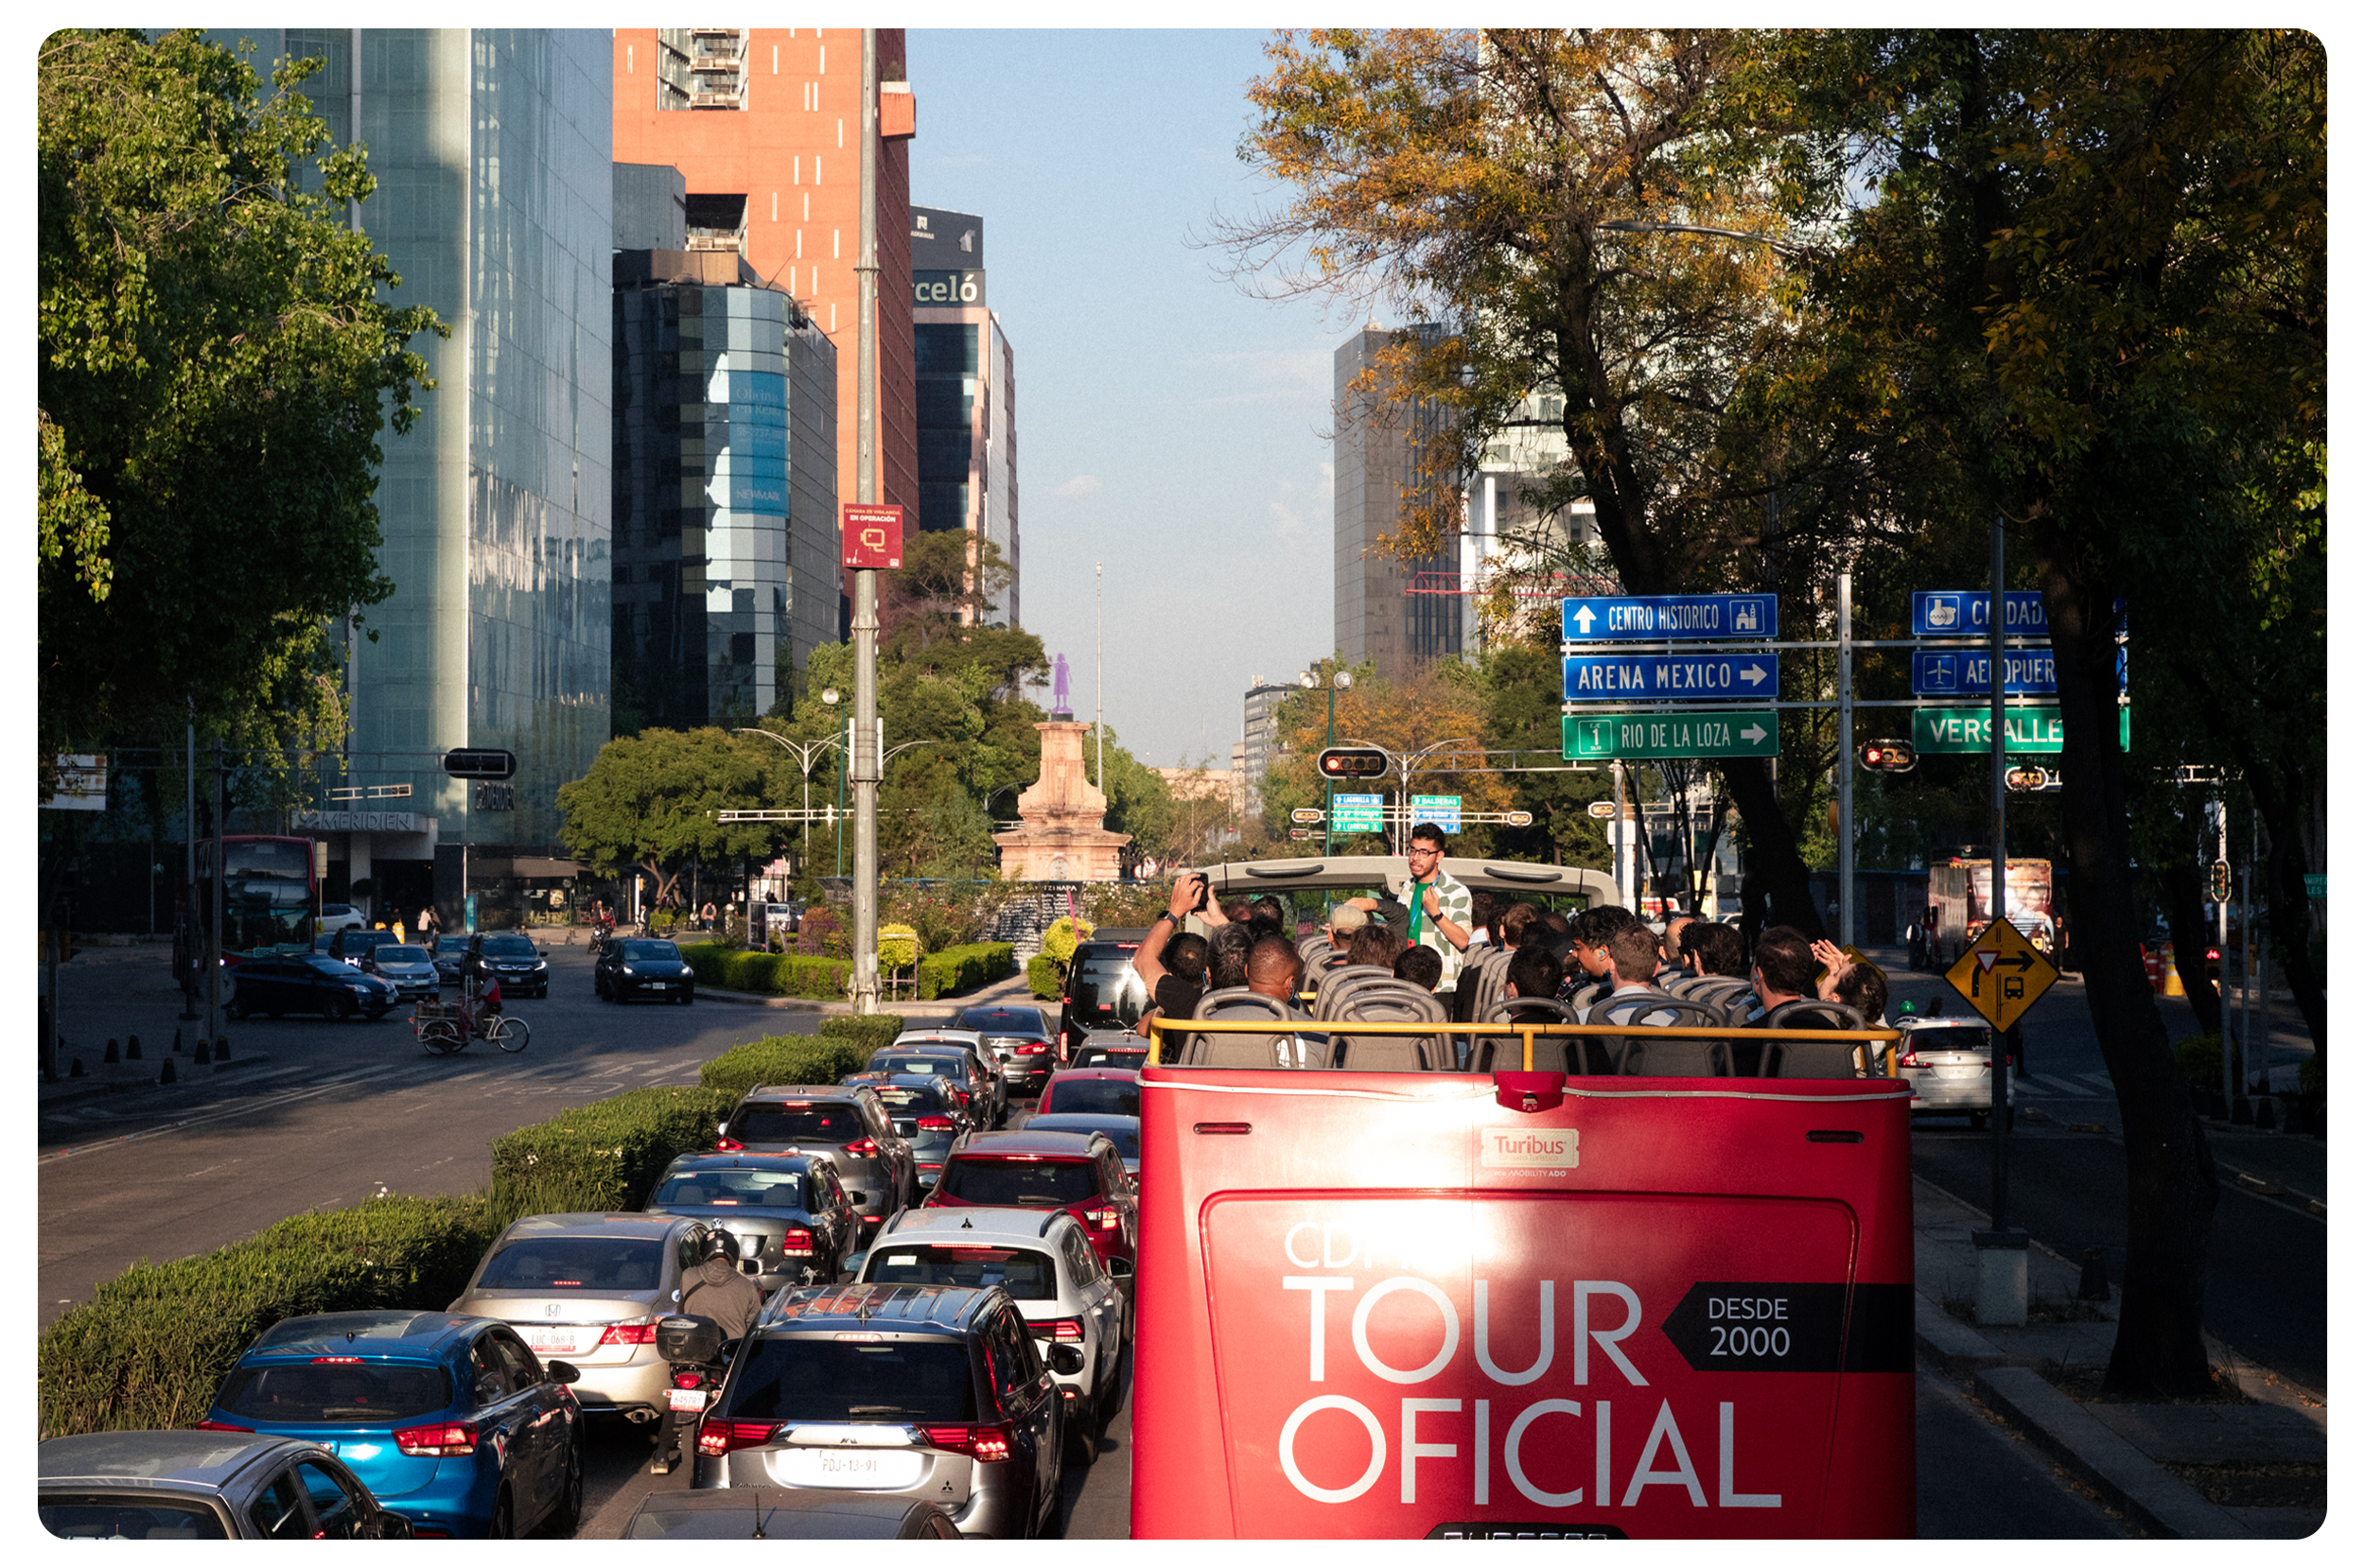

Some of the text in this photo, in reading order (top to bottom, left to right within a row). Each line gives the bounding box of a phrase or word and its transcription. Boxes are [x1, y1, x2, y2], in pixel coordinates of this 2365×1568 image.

[911, 273, 978, 303] celó
[1608, 604, 1719, 631] CENTRO HISTORICO
[1971, 601, 2049, 625] CIDAD
[1578, 663, 1730, 689] ARENA MEXICO
[1592, 728, 1599, 746] 1
[1621, 723, 1730, 748] RIO DE LA LOZA
[1422, 797, 1457, 806] BALDERAS
[321, 812, 411, 830] MERIDIEN
[1494, 1135, 1565, 1154] Turibus
[1708, 1298, 1788, 1319] DESDE
[1283, 1277, 1650, 1386] TOUR
[1709, 1326, 1791, 1357] 2000
[1279, 1394, 1782, 1508] OFICIAL
[822, 1458, 877, 1472] PDJ-13-91
